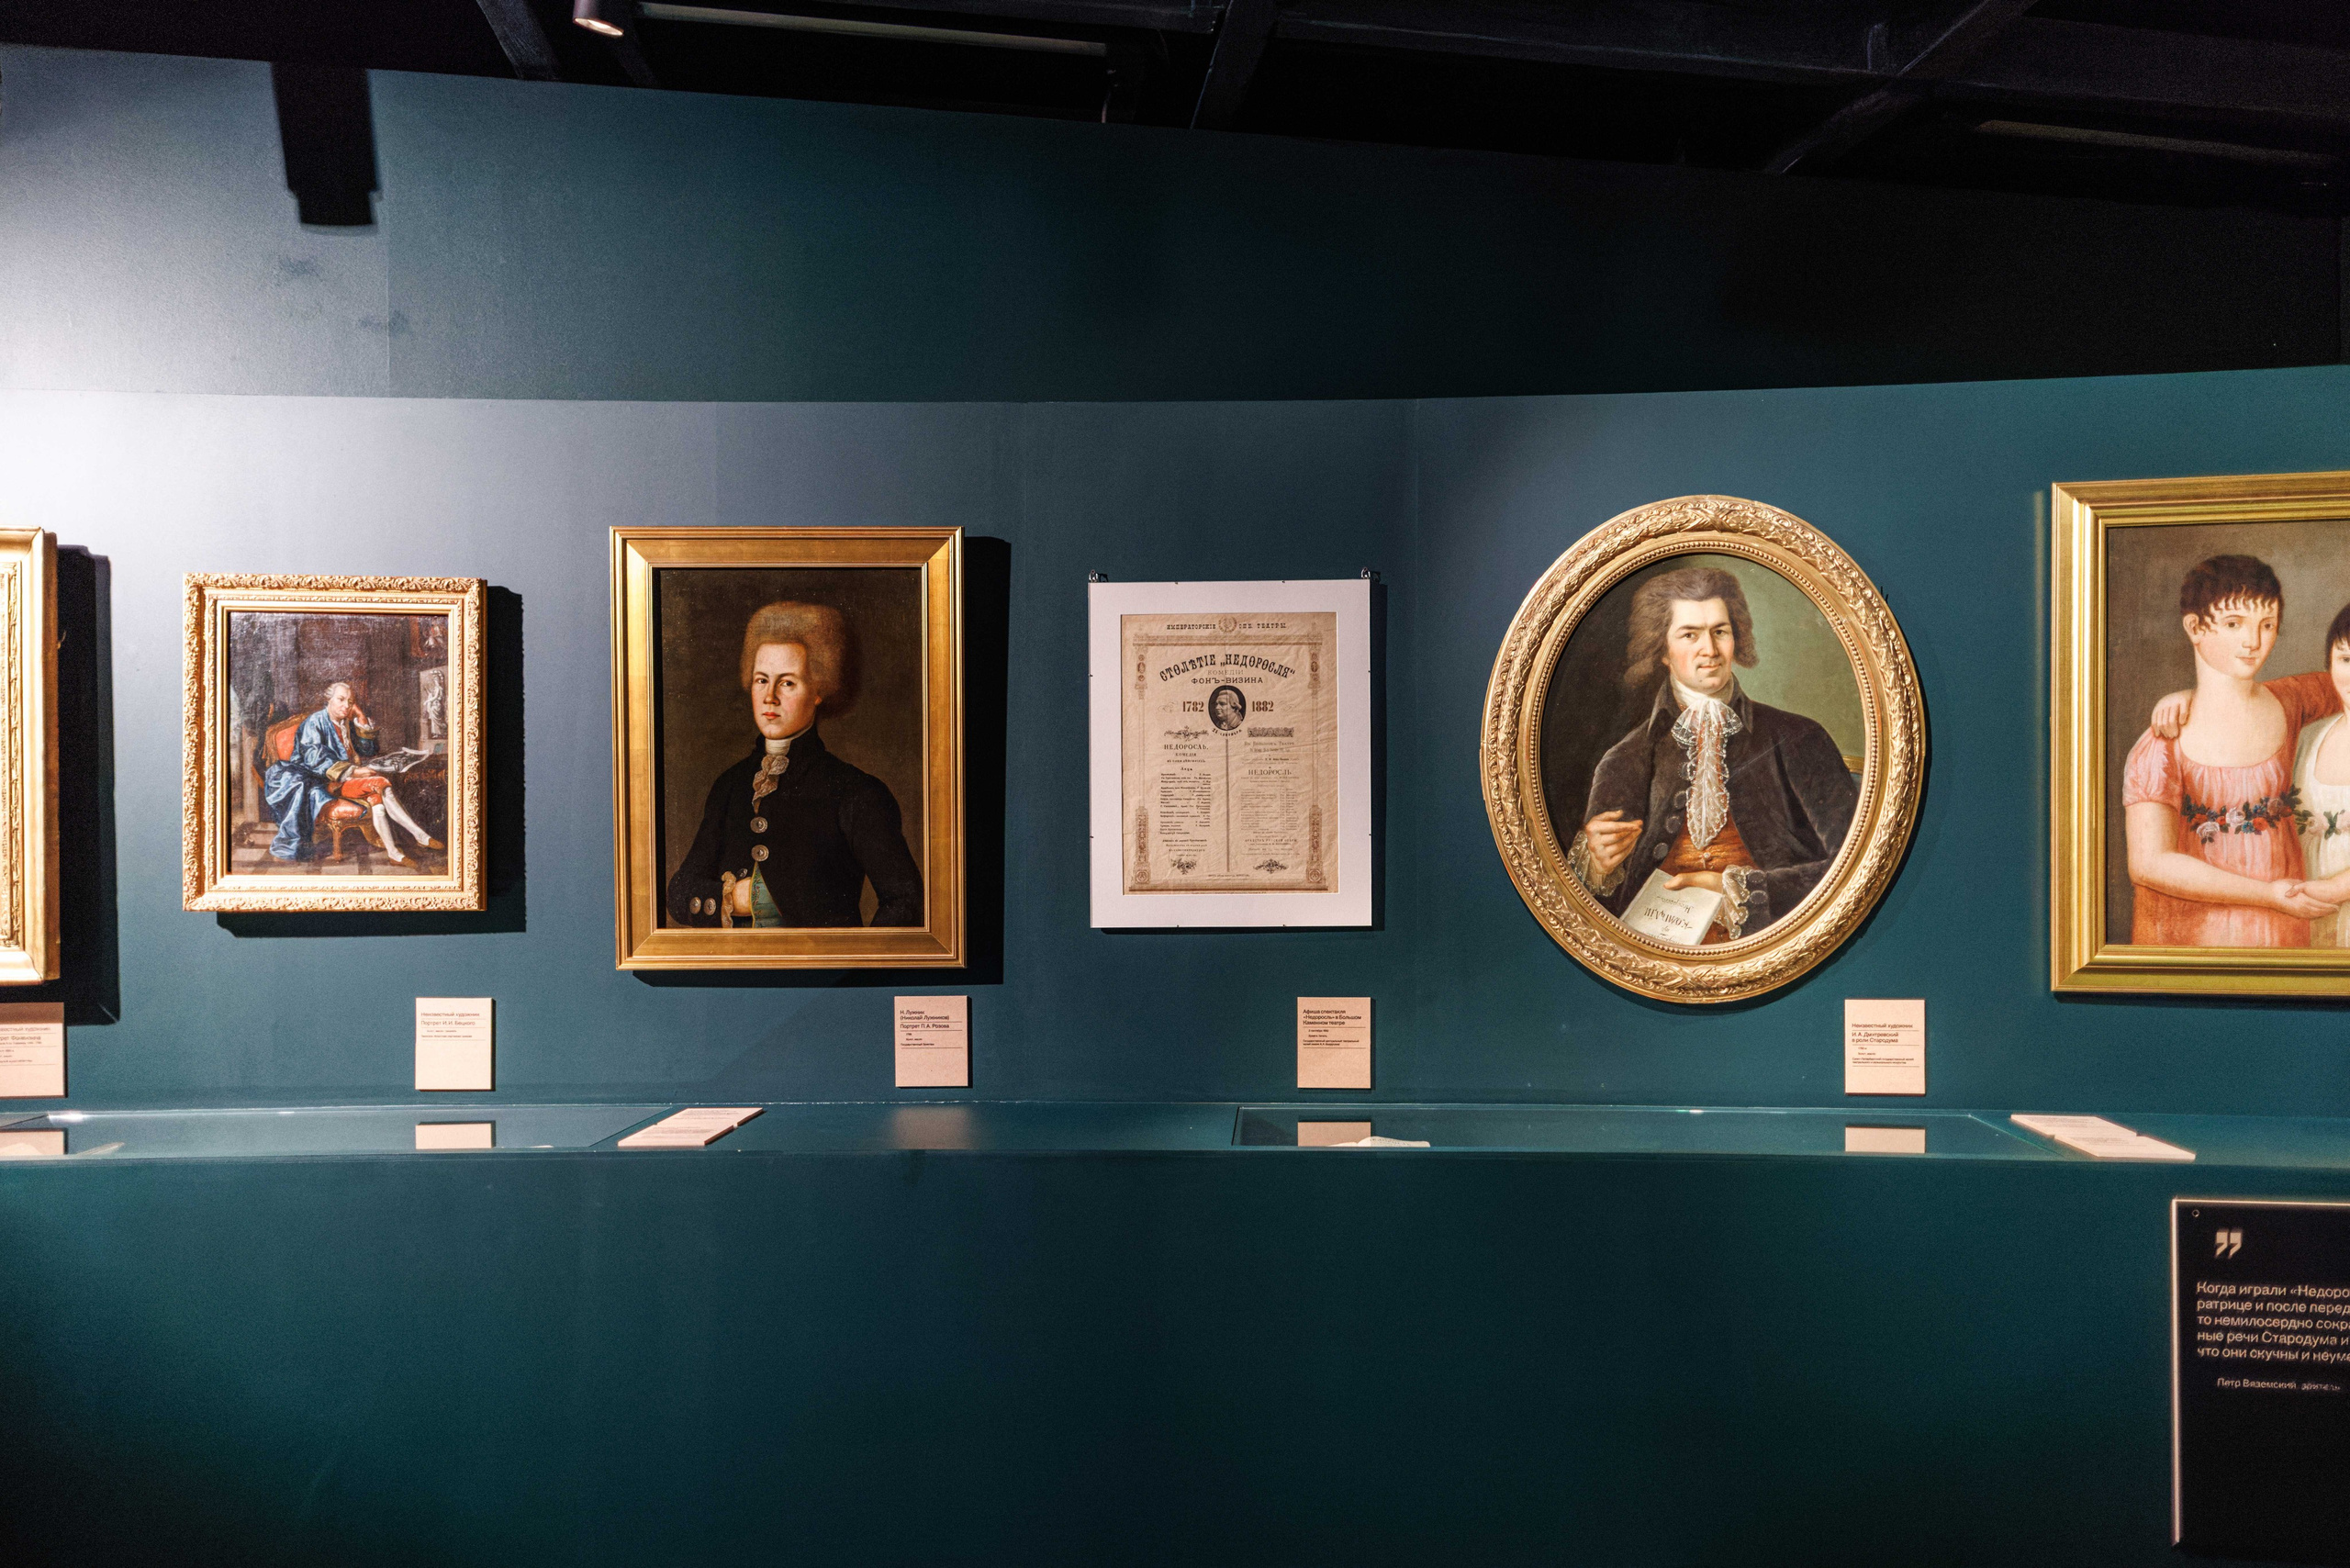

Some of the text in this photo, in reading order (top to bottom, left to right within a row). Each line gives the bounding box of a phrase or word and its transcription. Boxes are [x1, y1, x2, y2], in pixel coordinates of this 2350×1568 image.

[1182, 700, 1204, 712] 1782
[1252, 700, 1274, 712] 1882
[2196, 1282, 2236, 1296] Когда
[2239, 1284, 2286, 1296] играли
[2197, 1299, 2252, 1313] ратрице
[2255, 1302, 2263, 1311] и
[2266, 1302, 2306, 1312] после
[2197, 1316, 2212, 1325] то
[2215, 1316, 2313, 1330] немилосердно
[2197, 1331, 2349, 1348] ные речи Стародума и
[2197, 1347, 2219, 1357] что
[2222, 1349, 2247, 1358] они
[2250, 1350, 2298, 1361] скучны
[2301, 1351, 2310, 1361] и
[2217, 1378, 2240, 1388] Петр
